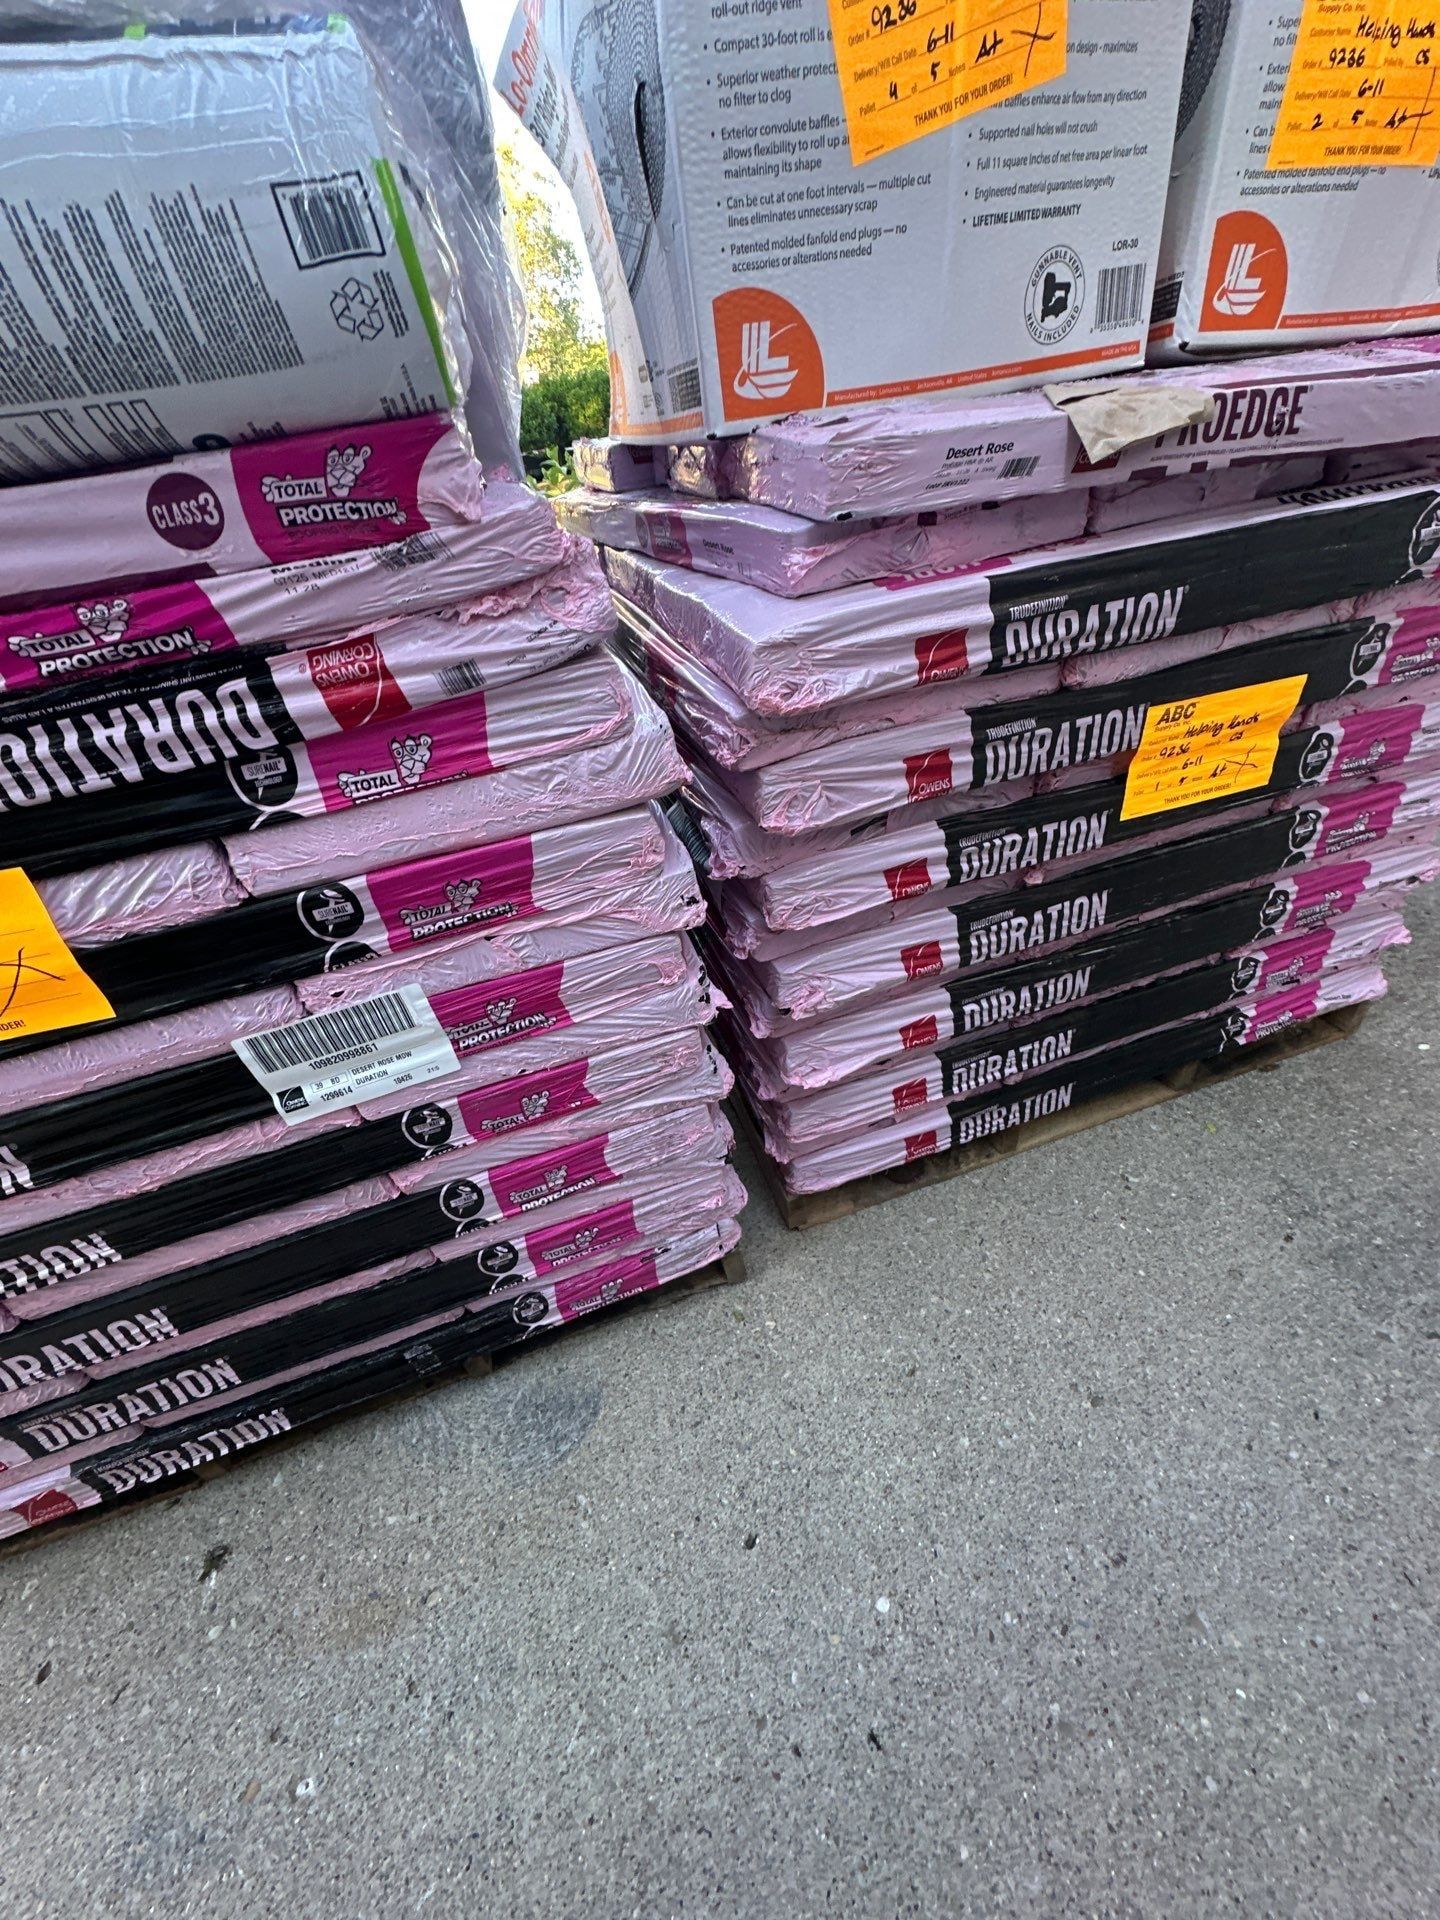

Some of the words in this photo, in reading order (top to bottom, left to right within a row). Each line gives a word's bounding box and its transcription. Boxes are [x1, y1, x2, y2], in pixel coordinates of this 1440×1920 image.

[711, 1, 750, 19] roll-out
[752, 0, 777, 17] ridge
[714, 35, 759, 54] Compact
[762, 29, 798, 48] 30-foot
[800, 28, 815, 43] roll
[817, 28, 824, 42] is
[1076, 40, 1098, 56] design
[1104, 40, 1139, 52] maximizes
[717, 69, 759, 88] Superior
[761, 64, 800, 82] weather
[803, 63, 838, 82] protect
[719, 98, 731, 108] no
[734, 92, 755, 106] filter
[757, 93, 768, 104] to
[770, 88, 791, 104] clog
[914, 108, 938, 126] THANK
[938, 102, 952, 117] YOU
[954, 96, 969, 110] FOR
[969, 87, 988, 104] YOUR
[989, 73, 1013, 94] ORDER!
[1031, 93, 1061, 107] enhance
[1062, 92, 1070, 104] air
[1071, 92, 1086, 104] flow
[1087, 91, 1102, 103] from
[1104, 92, 1115, 104] any
[1116, 88, 1147, 101] direction
[721, 124, 758, 141] Exterior
[760, 120, 806, 137] convolute
[809, 115, 840, 131] baffles
[979, 123, 1020, 142] Supported
[1021, 123, 1035, 137] nail
[1037, 122, 1054, 136] holes
[1055, 122, 1067, 134] will
[1068, 123, 1079, 133] not
[1080, 120, 1098, 132] crush
[1253, 125, 1268, 138] Can
[723, 146, 751, 160] allows
[753, 140, 796, 159] flexibility
[798, 140, 808, 151] to
[810, 136, 825, 149] roll
[827, 138, 840, 149] up
[977, 156, 990, 171] Full
[1002, 156, 1028, 170] square
[1029, 153, 1050, 165] inches
[1052, 151, 1059, 164] of
[1060, 151, 1071, 163] net
[1072, 150, 1085, 162] free
[1086, 150, 1100, 161] area
[1101, 150, 1113, 162] per
[1113, 146, 1132, 158] linear
[1133, 144, 1147, 156] foot
[724, 163, 779, 180] maintaining
[782, 160, 792, 172] its
[795, 158, 821, 172] shape
[726, 196, 745, 210] Can
[747, 195, 757, 208] be
[759, 193, 775, 206] cut
[776, 192, 785, 204] at
[787, 190, 804, 202] one
[806, 185, 824, 200] foot
[827, 181, 864, 197] intervals
[879, 175, 914, 190] multiple
[917, 173, 931, 186] cut
[975, 181, 1017, 201] Engineered
[1018, 180, 1045, 194] material
[1047, 178, 1083, 194] guarantees
[1084, 175, 1114, 191] longevity
[1240, 185, 1280, 197] accessories
[1281, 184, 1289, 193] or
[1291, 180, 1330, 193] alterations
[1331, 175, 1359, 191] needed
[728, 214, 748, 228] lines
[751, 208, 796, 225] eliminates
[798, 201, 853, 219] unnecessary
[855, 199, 878, 213] scrap
[973, 210, 1008, 228] LIFETIME
[1010, 207, 1040, 224] LIMITED
[1041, 203, 1081, 219] WARRANTY
[730, 238, 770, 255] Patented
[772, 235, 805, 251] molded
[807, 230, 838, 246] fanfold
[840, 228, 856, 242] end
[859, 225, 882, 243] plugs
[896, 224, 907, 235] no
[1112, 237, 1139, 251] LOR-30
[732, 257, 780, 273] accessories
[782, 255, 791, 266] or
[793, 249, 838, 265] alterations
[839, 243, 872, 258] needed
[1031, 249, 1067, 288] GUNNABLE
[1068, 251, 1083, 280] VENT
[1026, 312, 1042, 340] NAILS
[1044, 305, 1079, 341] INCLUDED
[946, 443, 983, 460] Desert
[985, 441, 1014, 455] Rose
[273, 481, 323, 500] TOTAL
[152, 499, 201, 530] CLASS
[197, 491, 221, 527] 3
[279, 499, 399, 528] PROTECTION
[1009, 595, 1066, 621] TRUDEFINITION
[1001, 585, 1184, 669] DURATION
[25, 633, 91, 654] TOTAL
[39, 629, 196, 677] PROTECTION
[312, 642, 374, 667] CORNING
[316, 662, 371, 687] OWENS
[1154, 702, 1197, 727] ABC
[986, 718, 1036, 741] TRUDEFINITION
[0, 677, 279, 814] DURATIO
[983, 703, 1146, 786] DURATION
[248, 761, 281, 777] SURENAIL
[352, 773, 397, 793] TOTAL
[919, 778, 950, 794] OWENS
[1164, 796, 1180, 805] THANK
[1181, 793, 1190, 801] YOU
[1191, 790, 1201, 799] FOR
[1201, 787, 1213, 796] YOUR
[1214, 783, 1232, 794] ORDER!
[959, 810, 1108, 884] DURATION
[411, 907, 449, 923] TOTAL
[412, 903, 512, 939] PROTECTION
[969, 890, 1108, 965] DURATION
[963, 966, 1092, 1032] DURATION
[459, 1011, 546, 1051] PROTECTION
[308, 1043, 379, 1072] 109820998861
[351, 1061, 376, 1076] DESERT
[377, 1056, 396, 1068] ROSE
[396, 1050, 412, 1063] MDW
[952, 1029, 1073, 1095] DURATION
[315, 1081, 324, 1090] 39
[355, 1069, 389, 1085] DURATION
[320, 1086, 353, 1102] 1299614
[960, 1082, 1073, 1144] DURATION
[516, 1185, 548, 1201] TOTAL
[23, 1357, 241, 1452] DURATION
[100, 1409, 292, 1494] DURATION
